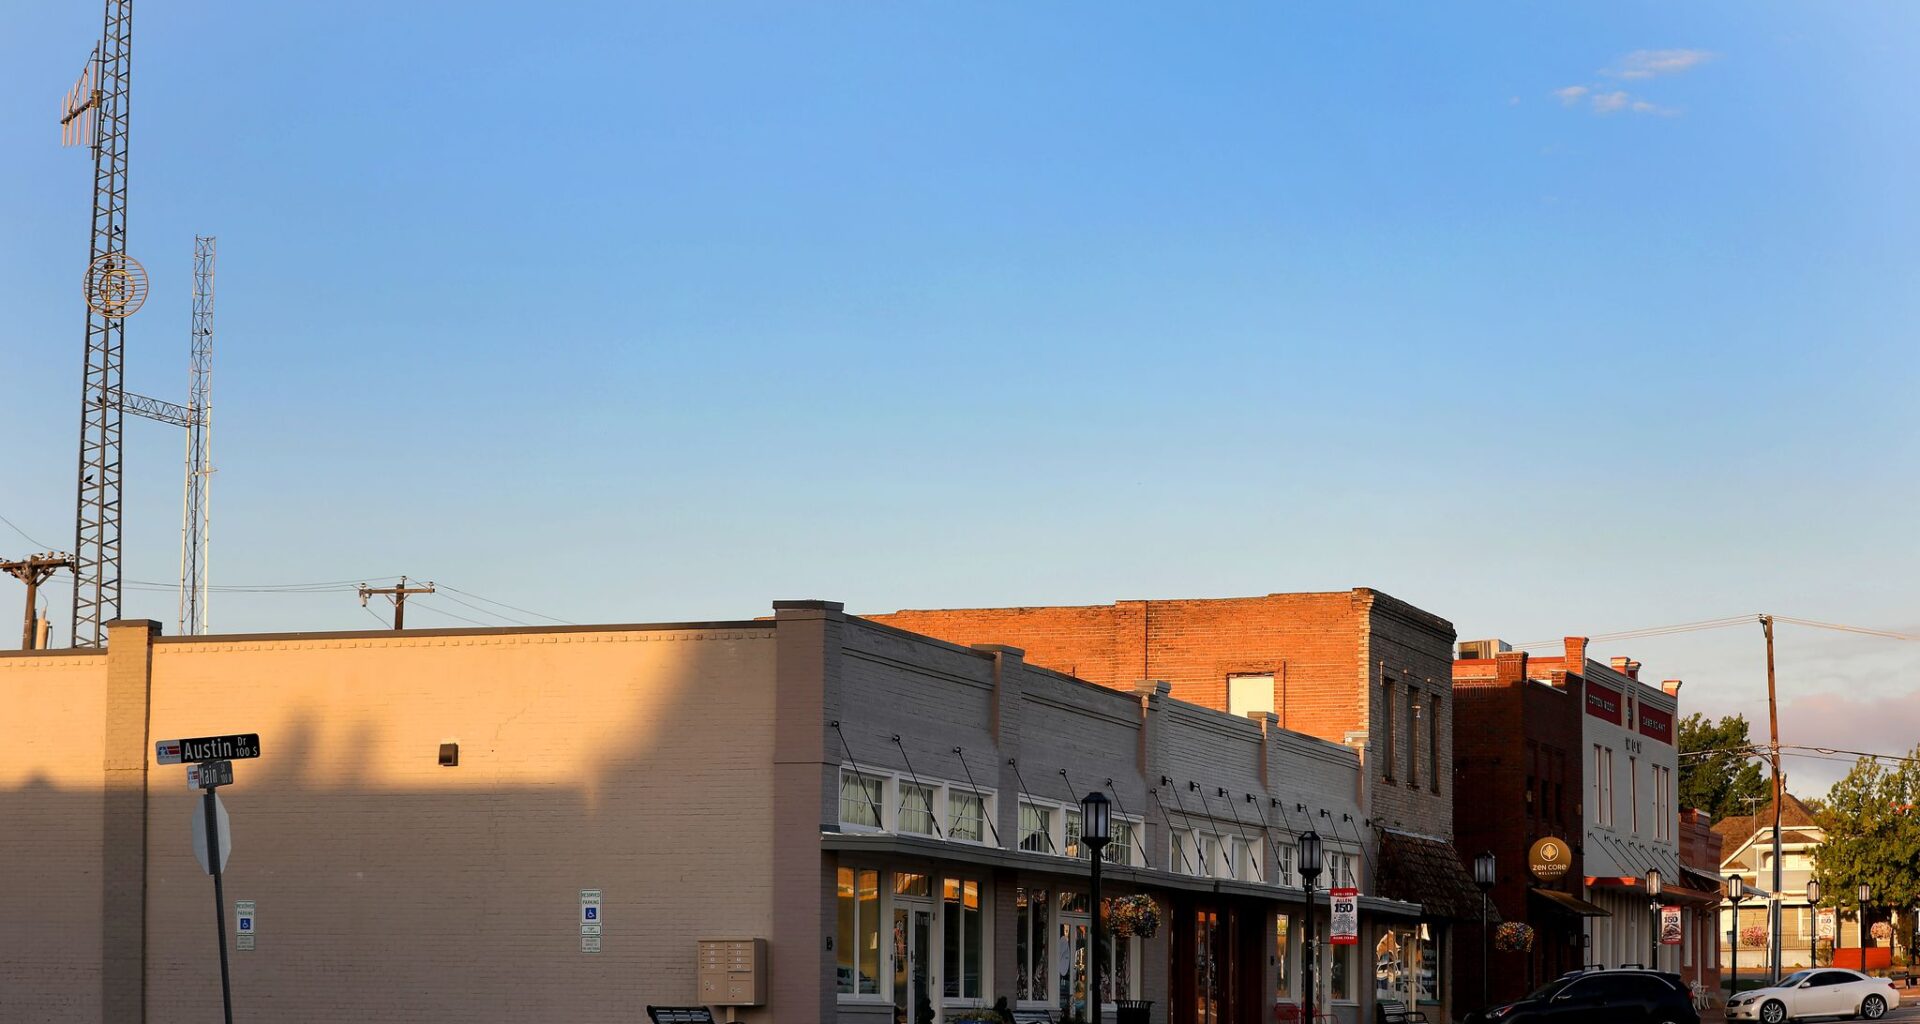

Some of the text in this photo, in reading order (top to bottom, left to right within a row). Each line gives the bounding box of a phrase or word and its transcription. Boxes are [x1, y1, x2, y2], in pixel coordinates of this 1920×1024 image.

[184, 736, 247, 760] Austin Dr
[235, 746, 258, 757] 100 S
[199, 766, 218, 785] Main
[1334, 903, 1354, 913] 150
